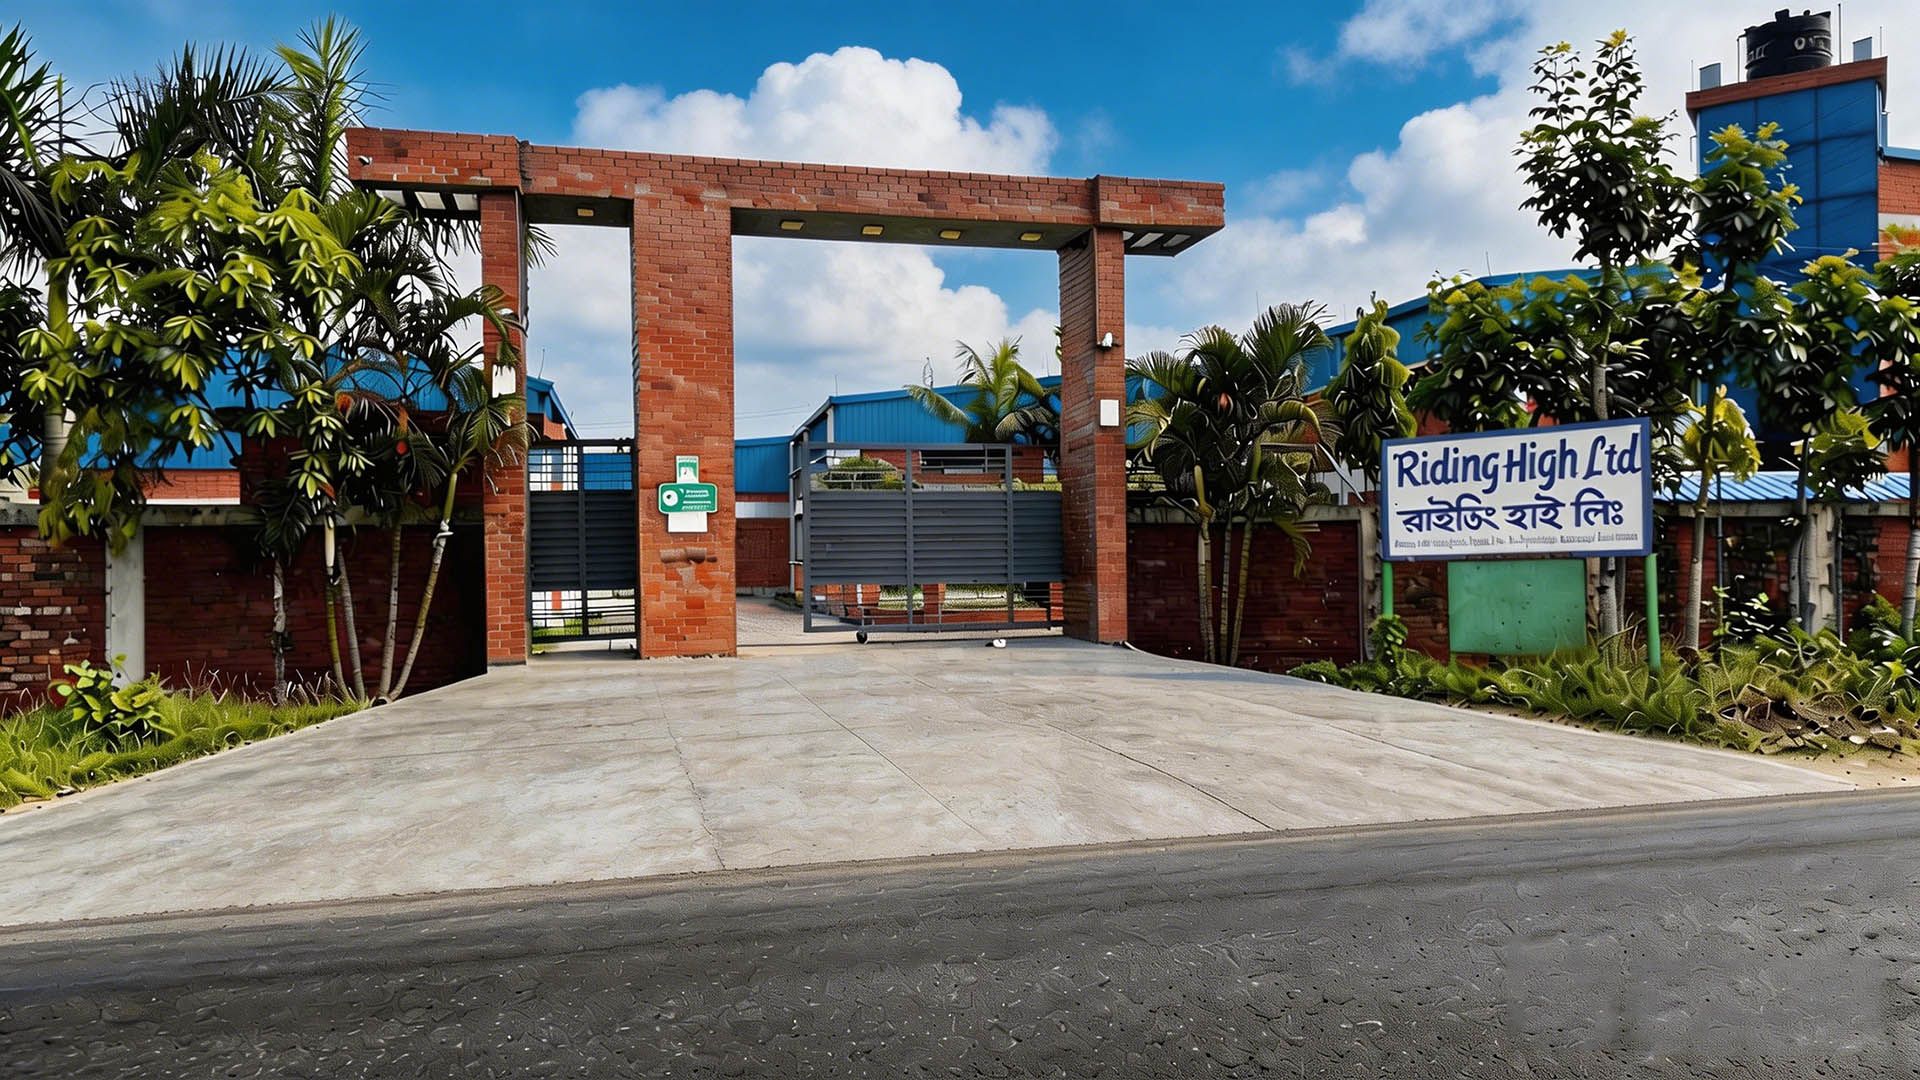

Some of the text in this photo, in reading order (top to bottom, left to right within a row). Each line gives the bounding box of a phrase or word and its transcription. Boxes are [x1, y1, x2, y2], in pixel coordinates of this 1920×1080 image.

[1393, 433, 1642, 494] Riding High Ltd
[1396, 493, 1500, 533] রাইডিং
[1502, 493, 1566, 530] হাই
